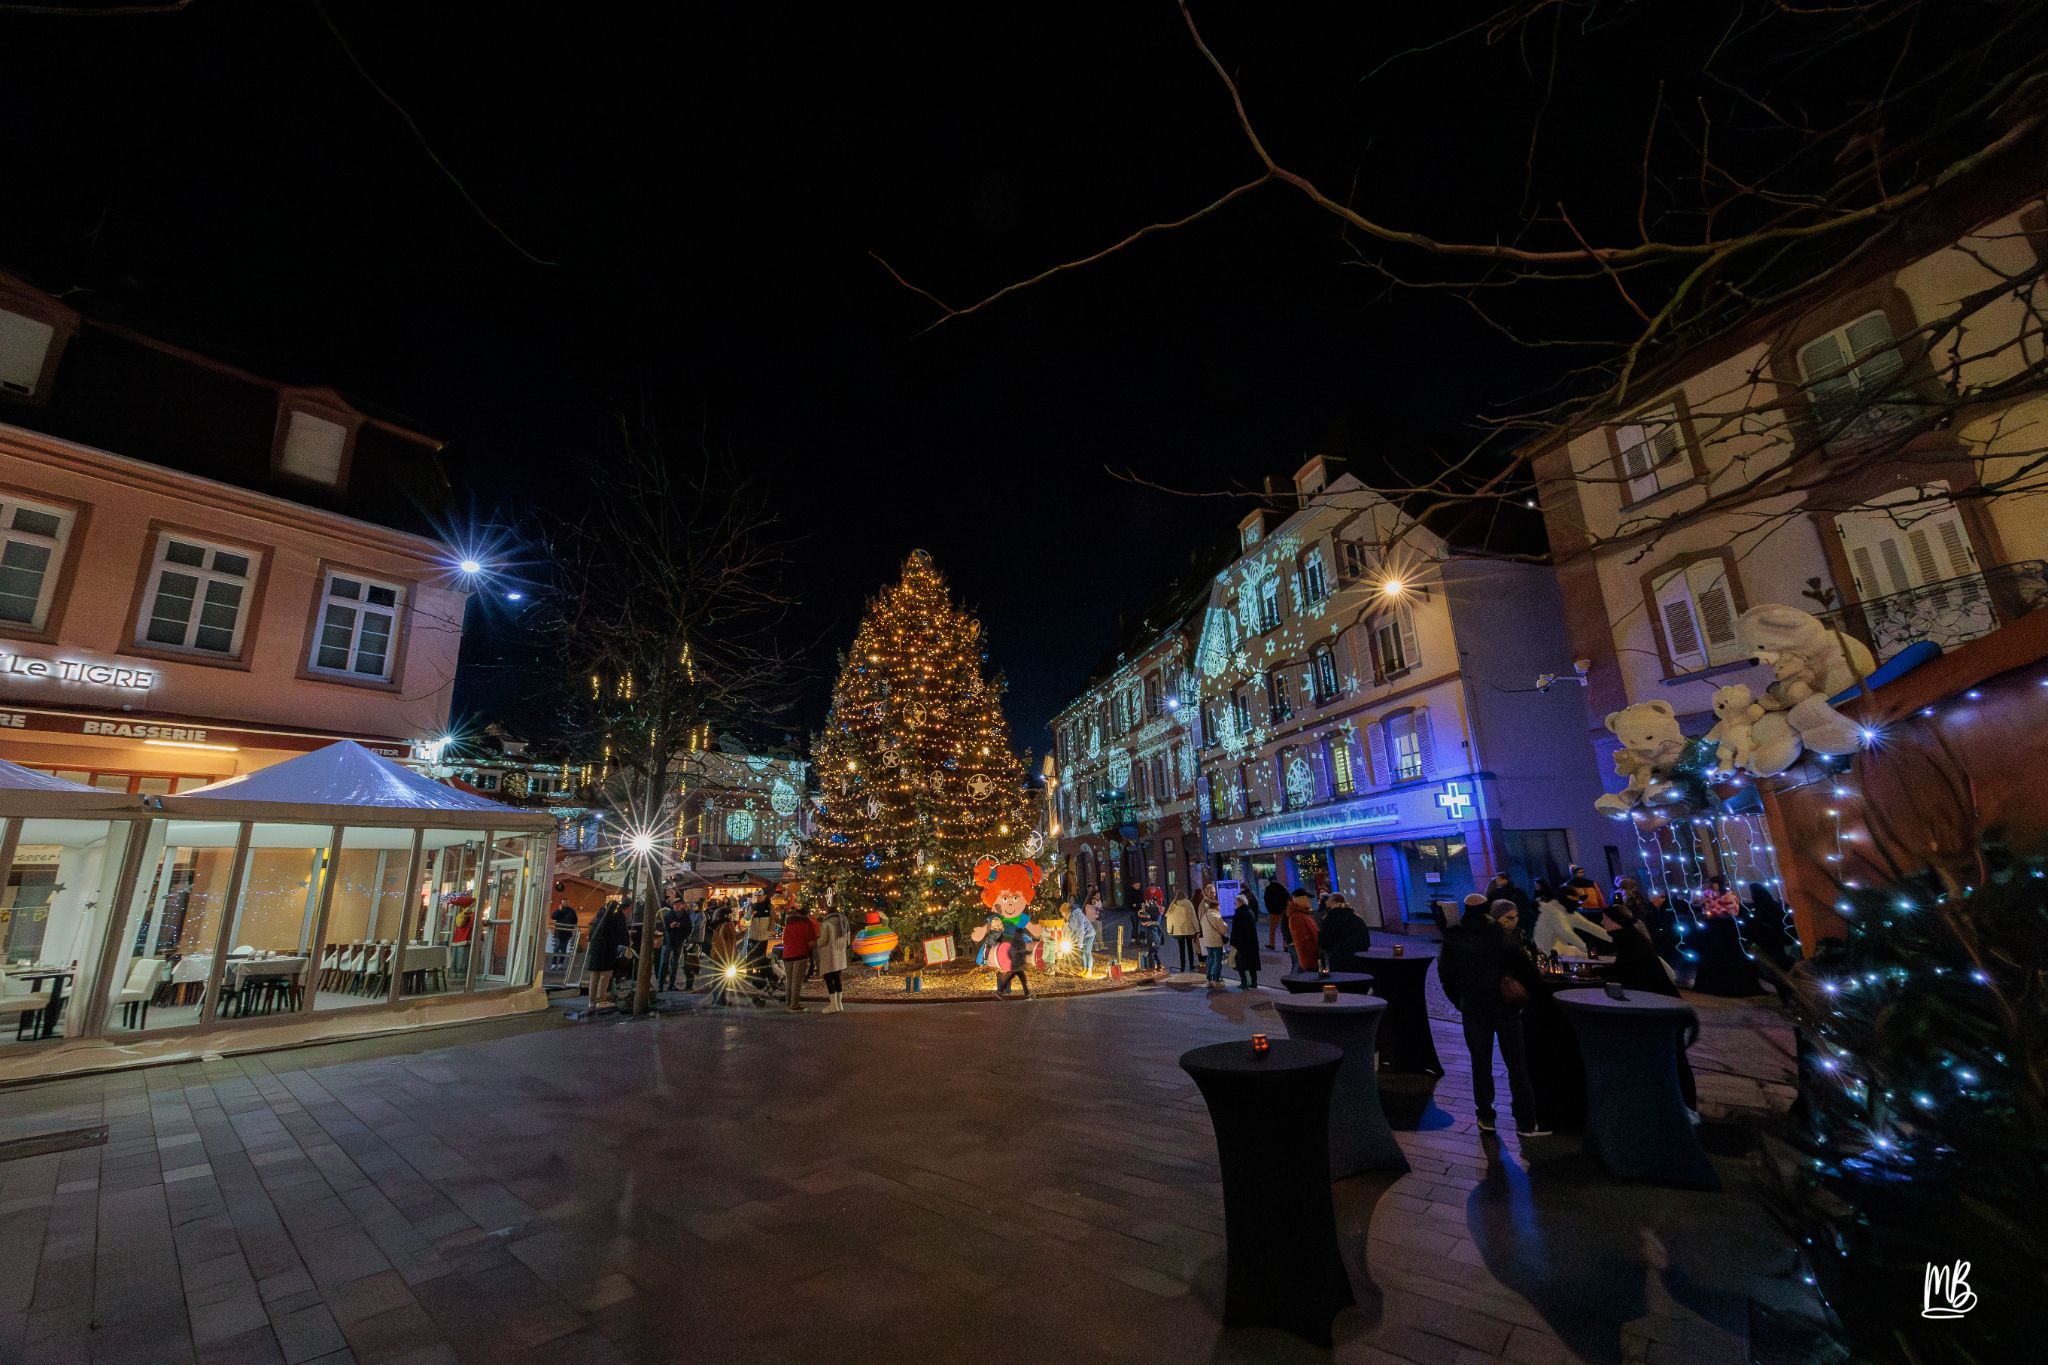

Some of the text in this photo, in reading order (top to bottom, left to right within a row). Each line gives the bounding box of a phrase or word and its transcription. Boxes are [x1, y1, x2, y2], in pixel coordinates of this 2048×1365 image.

[11, 654, 153, 689] Le TIGRE
[83, 720, 207, 742] BRASSERIE
